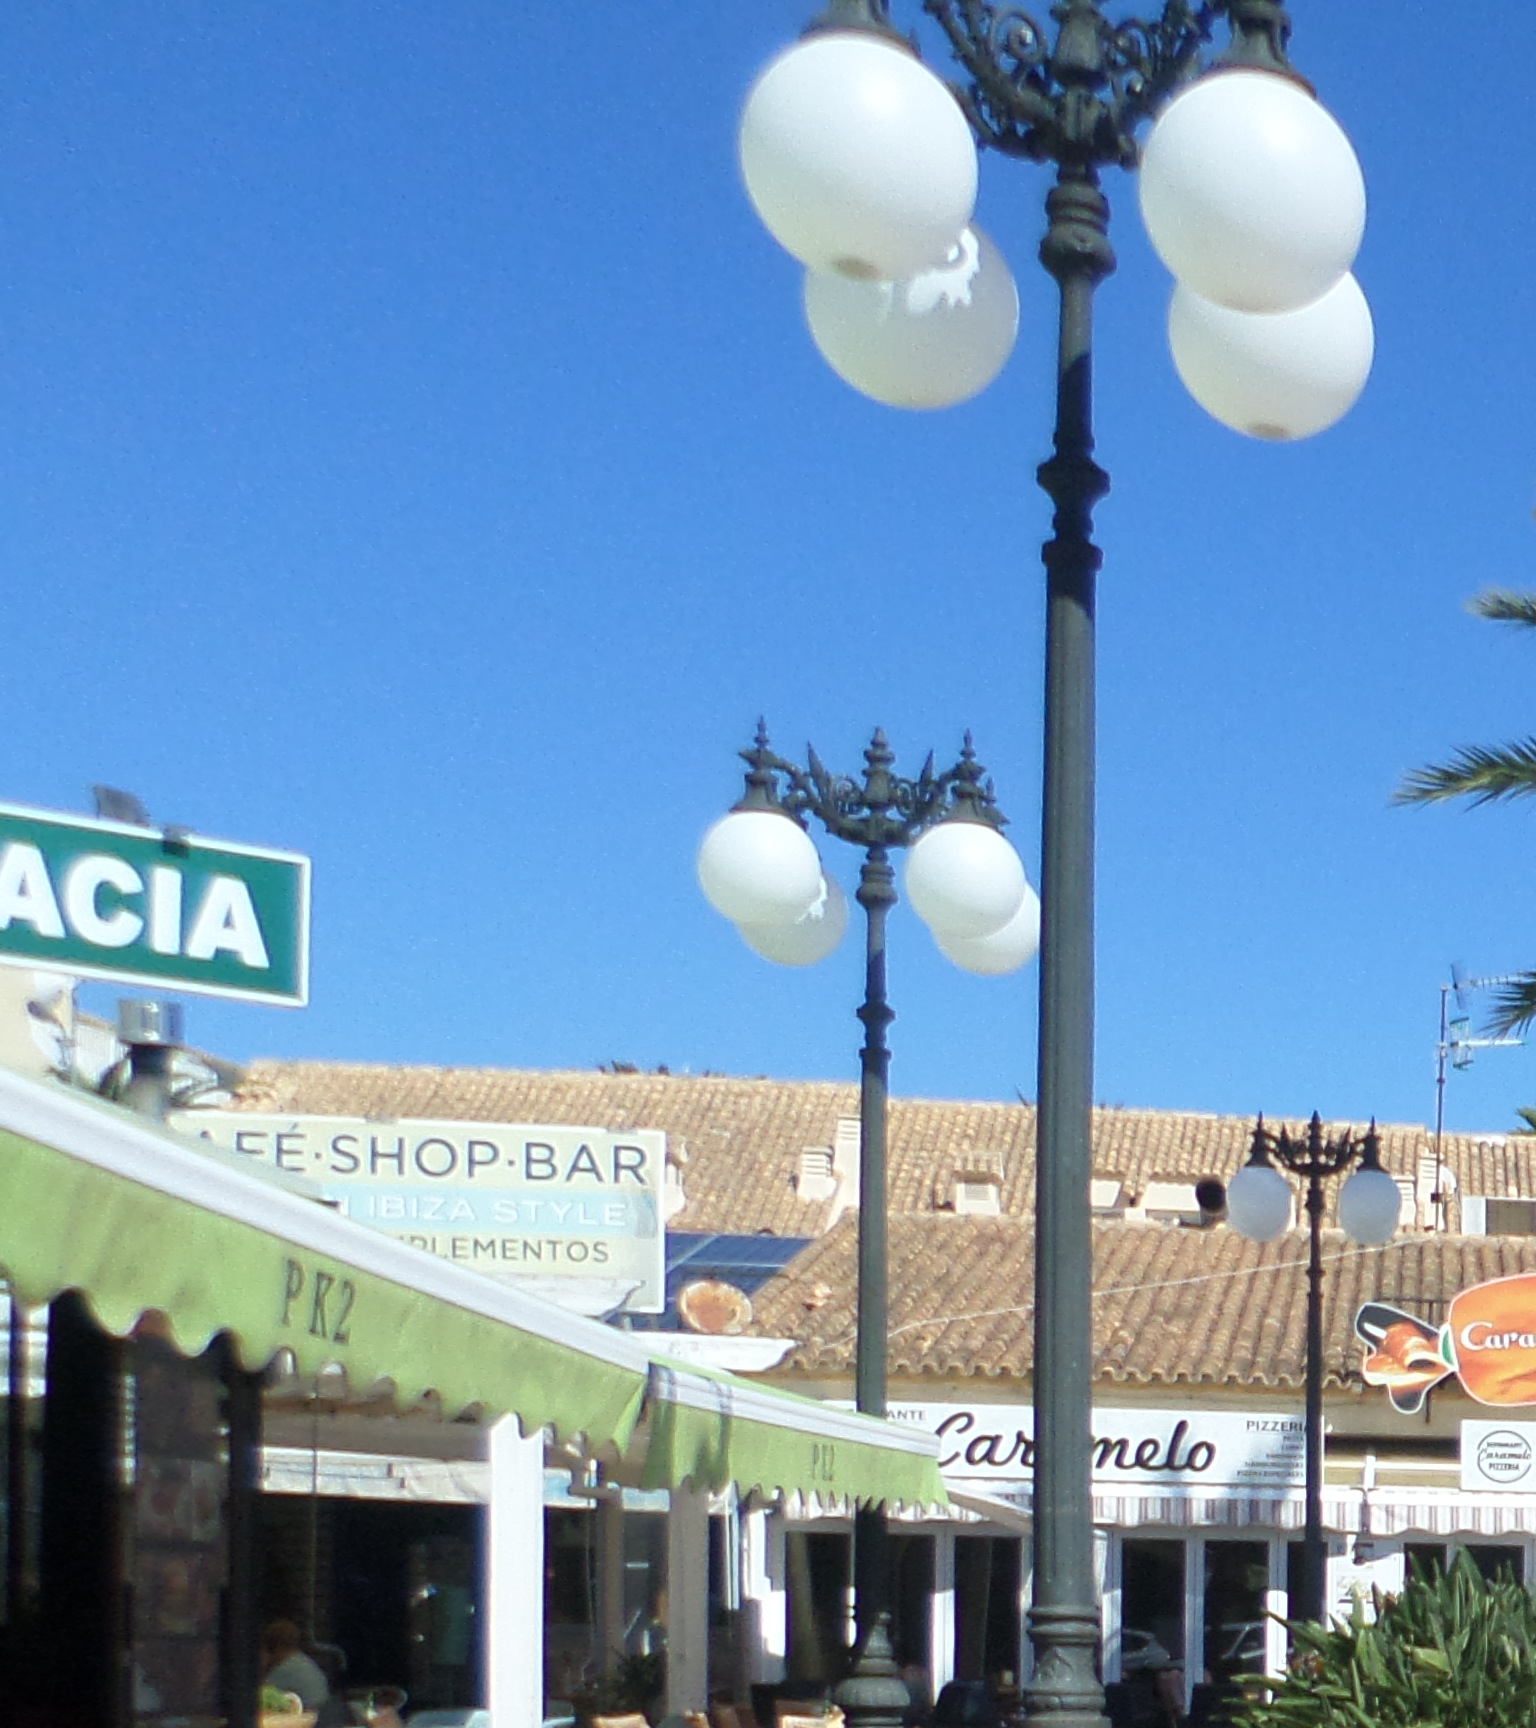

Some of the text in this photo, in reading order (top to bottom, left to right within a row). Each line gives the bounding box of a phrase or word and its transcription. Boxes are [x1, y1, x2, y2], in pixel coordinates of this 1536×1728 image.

[369, 1196, 477, 1221] IBIZA
[493, 1200, 629, 1227] STYLE
[282, 1258, 356, 1346] PK2
[935, 1411, 1217, 1472] Carmelo
[1246, 1420, 1306, 1433] PIZZERI
